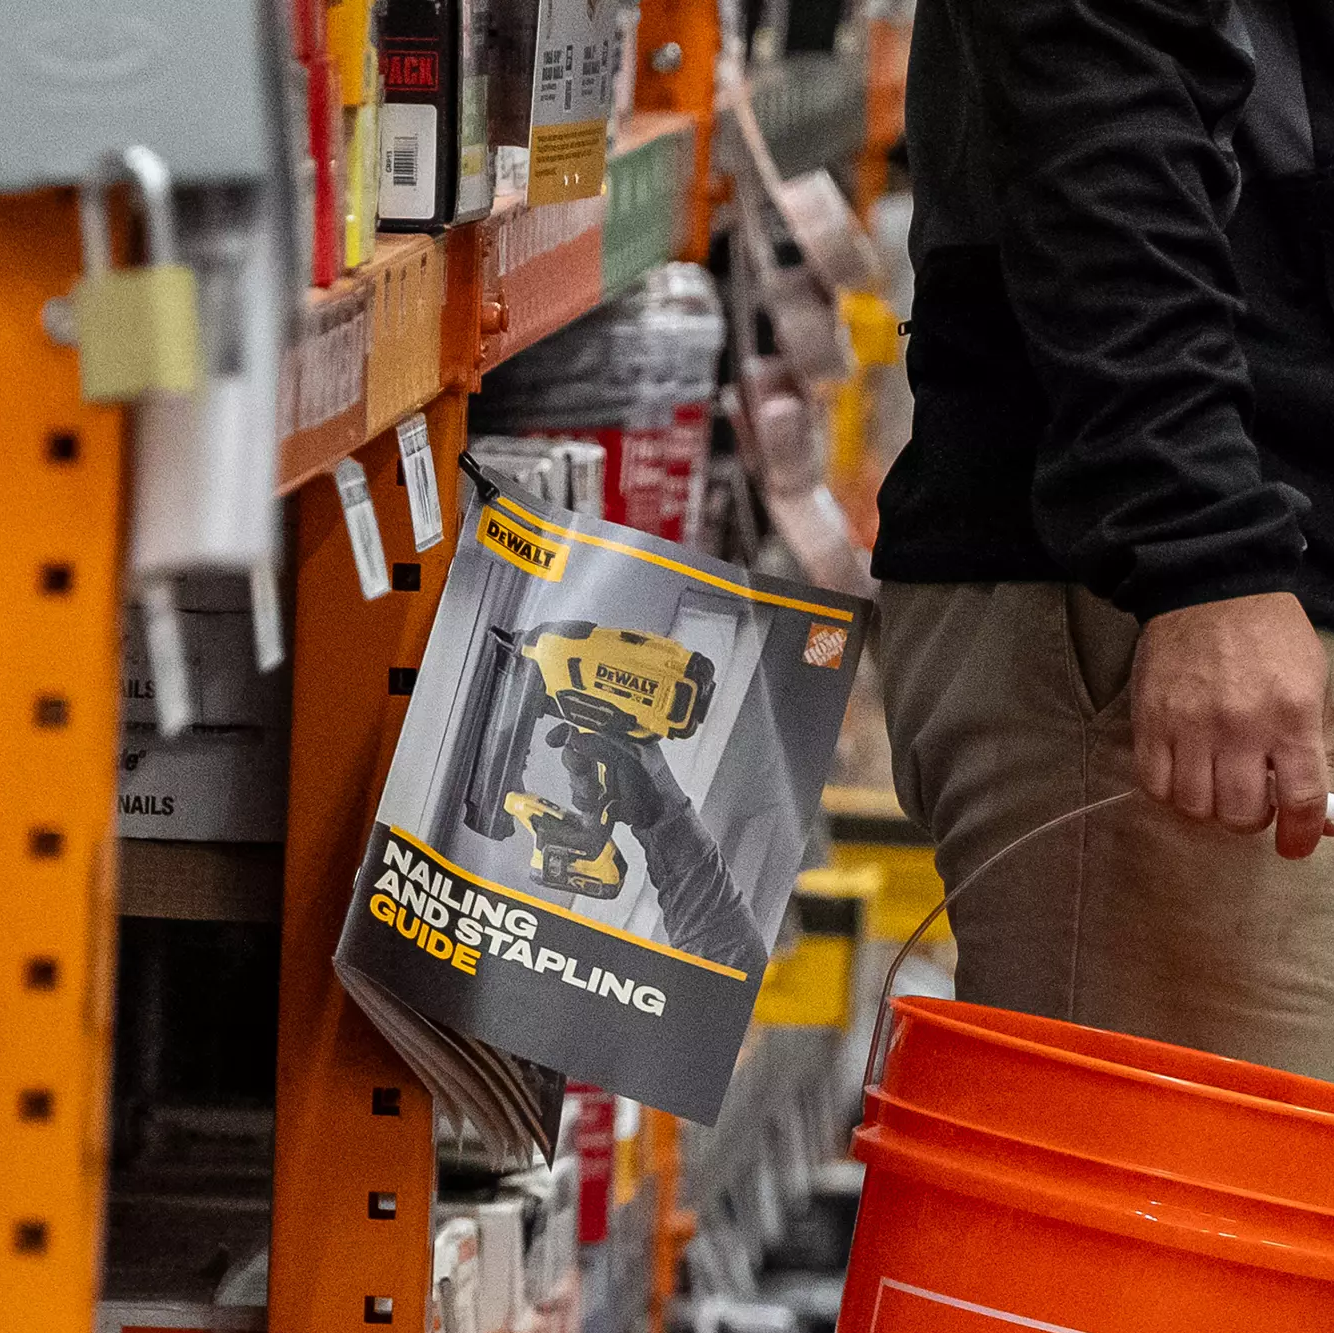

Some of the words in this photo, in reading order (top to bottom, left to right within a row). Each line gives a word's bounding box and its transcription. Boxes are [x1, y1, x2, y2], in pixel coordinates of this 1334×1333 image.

[370, 893, 481, 975] GUIDE
[382, 840, 539, 940] NAILING
[374, 870, 449, 928] AND
[455, 917, 666, 1016] STAPLING
